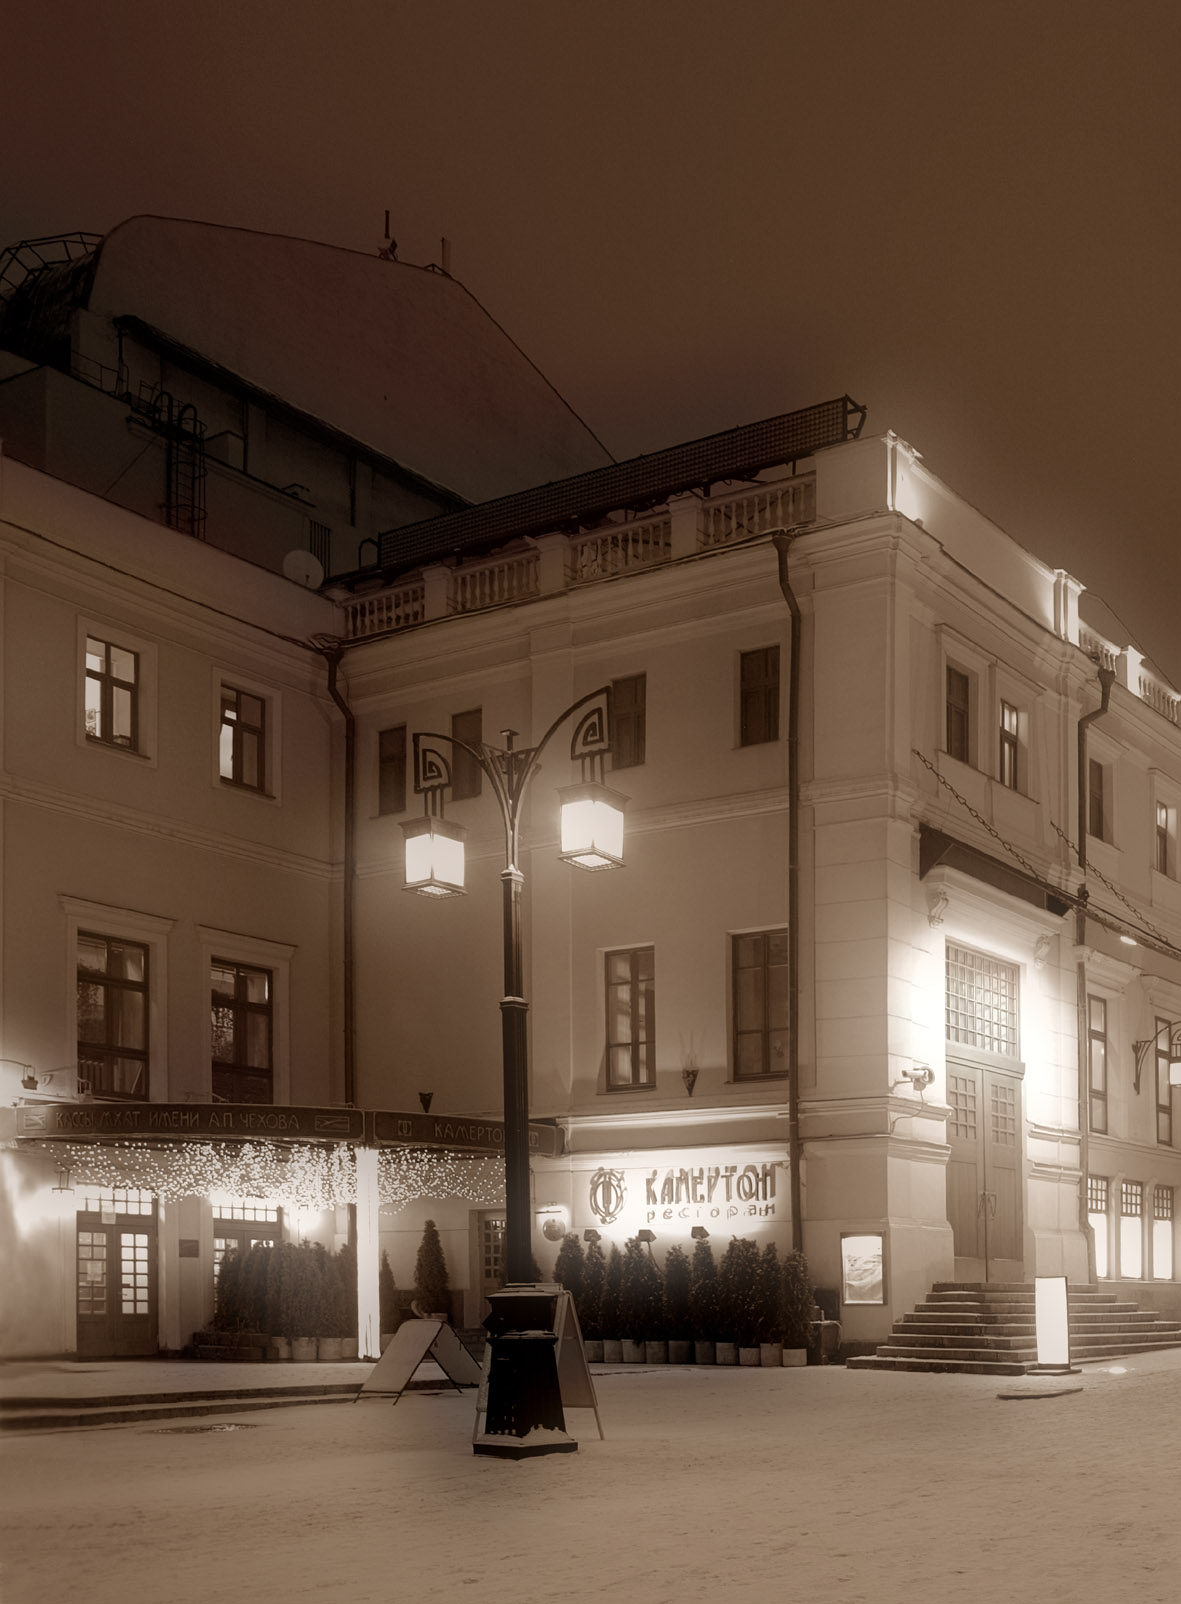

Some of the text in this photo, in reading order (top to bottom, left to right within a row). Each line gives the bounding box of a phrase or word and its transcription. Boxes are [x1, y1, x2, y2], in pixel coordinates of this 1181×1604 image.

[56, 1112, 94, 1129] КАССЫ
[102, 1112, 140, 1129] МХАТ
[149, 1112, 199, 1128] ИМЕНИ
[240, 1113, 300, 1130] ЧЕХОВА
[645, 1164, 776, 1205] КАМЕРТОН
[646, 1204, 776, 1223] ресторан
